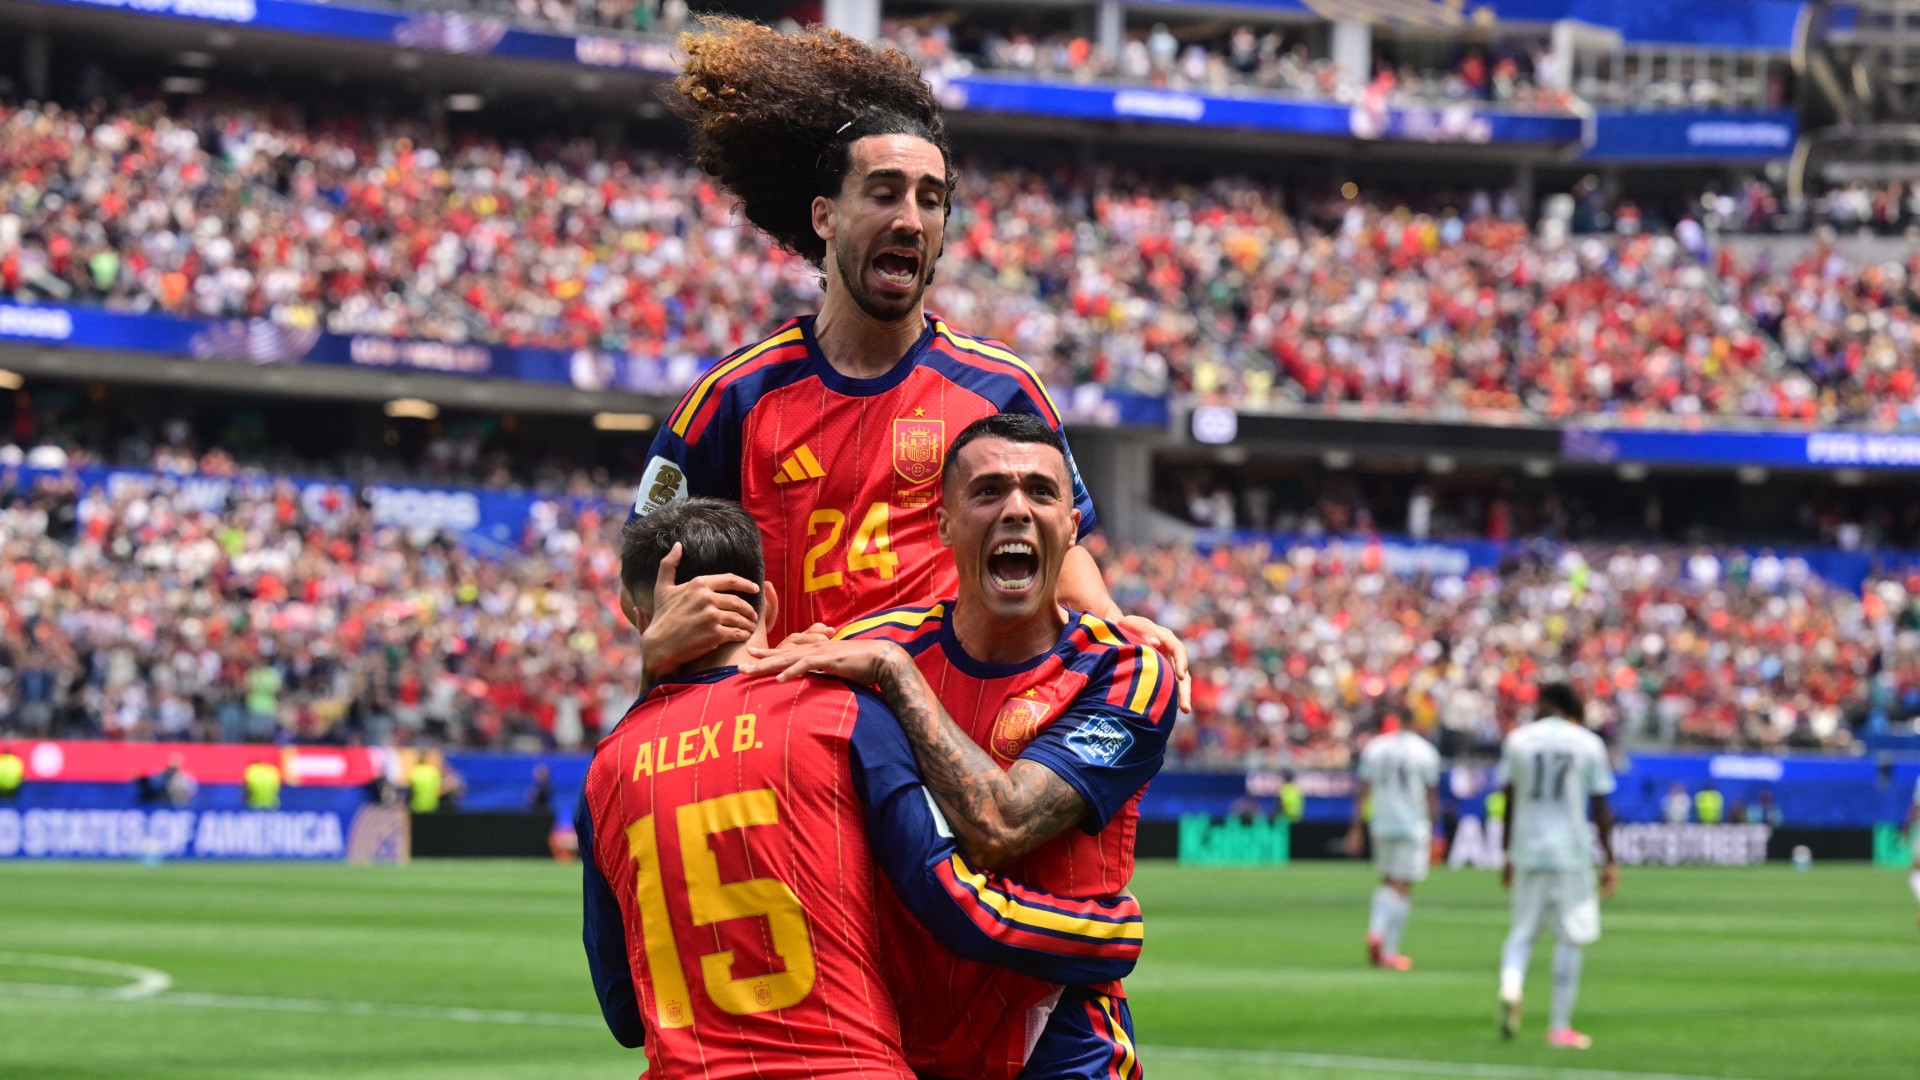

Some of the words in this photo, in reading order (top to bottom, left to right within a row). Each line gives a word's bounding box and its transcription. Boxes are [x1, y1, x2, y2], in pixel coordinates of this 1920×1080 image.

[803, 502, 899, 593] 24
[632, 720, 724, 782] ALEX
[732, 713, 764, 753] B.
[1097, 718, 1126, 746] FOOTBALL
[1532, 752, 1575, 800] 17
[23, 808, 147, 857] STATES
[149, 809, 196, 857] OF
[194, 811, 344, 858] AMERICA
[624, 788, 817, 1029] 15
